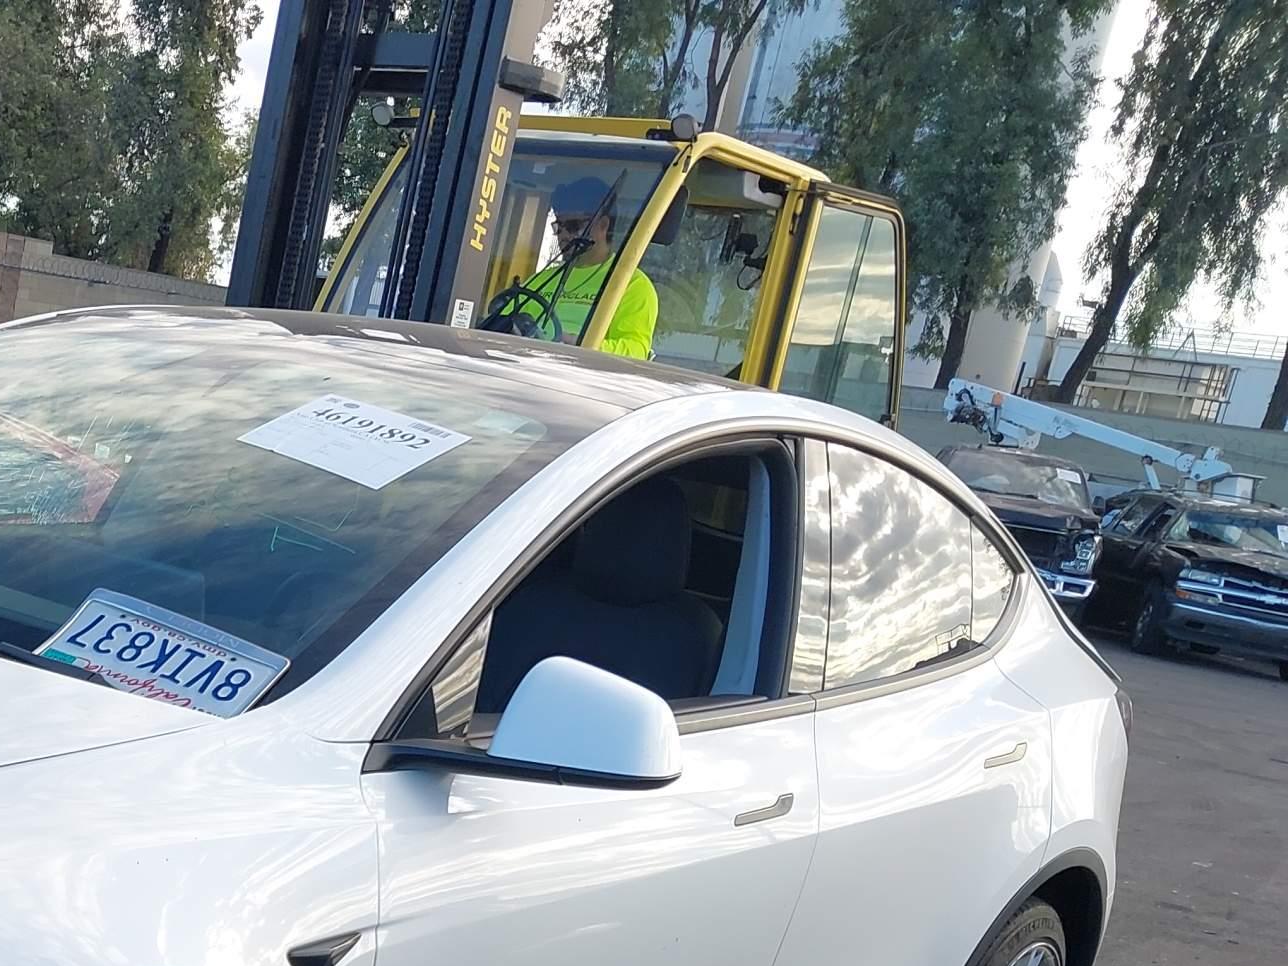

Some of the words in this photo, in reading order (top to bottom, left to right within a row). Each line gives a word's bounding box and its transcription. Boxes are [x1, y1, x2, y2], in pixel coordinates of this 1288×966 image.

[469, 105, 512, 252] HYSTER
[312, 407, 432, 449] 46191892
[66, 614, 253, 702] 8VIK837
